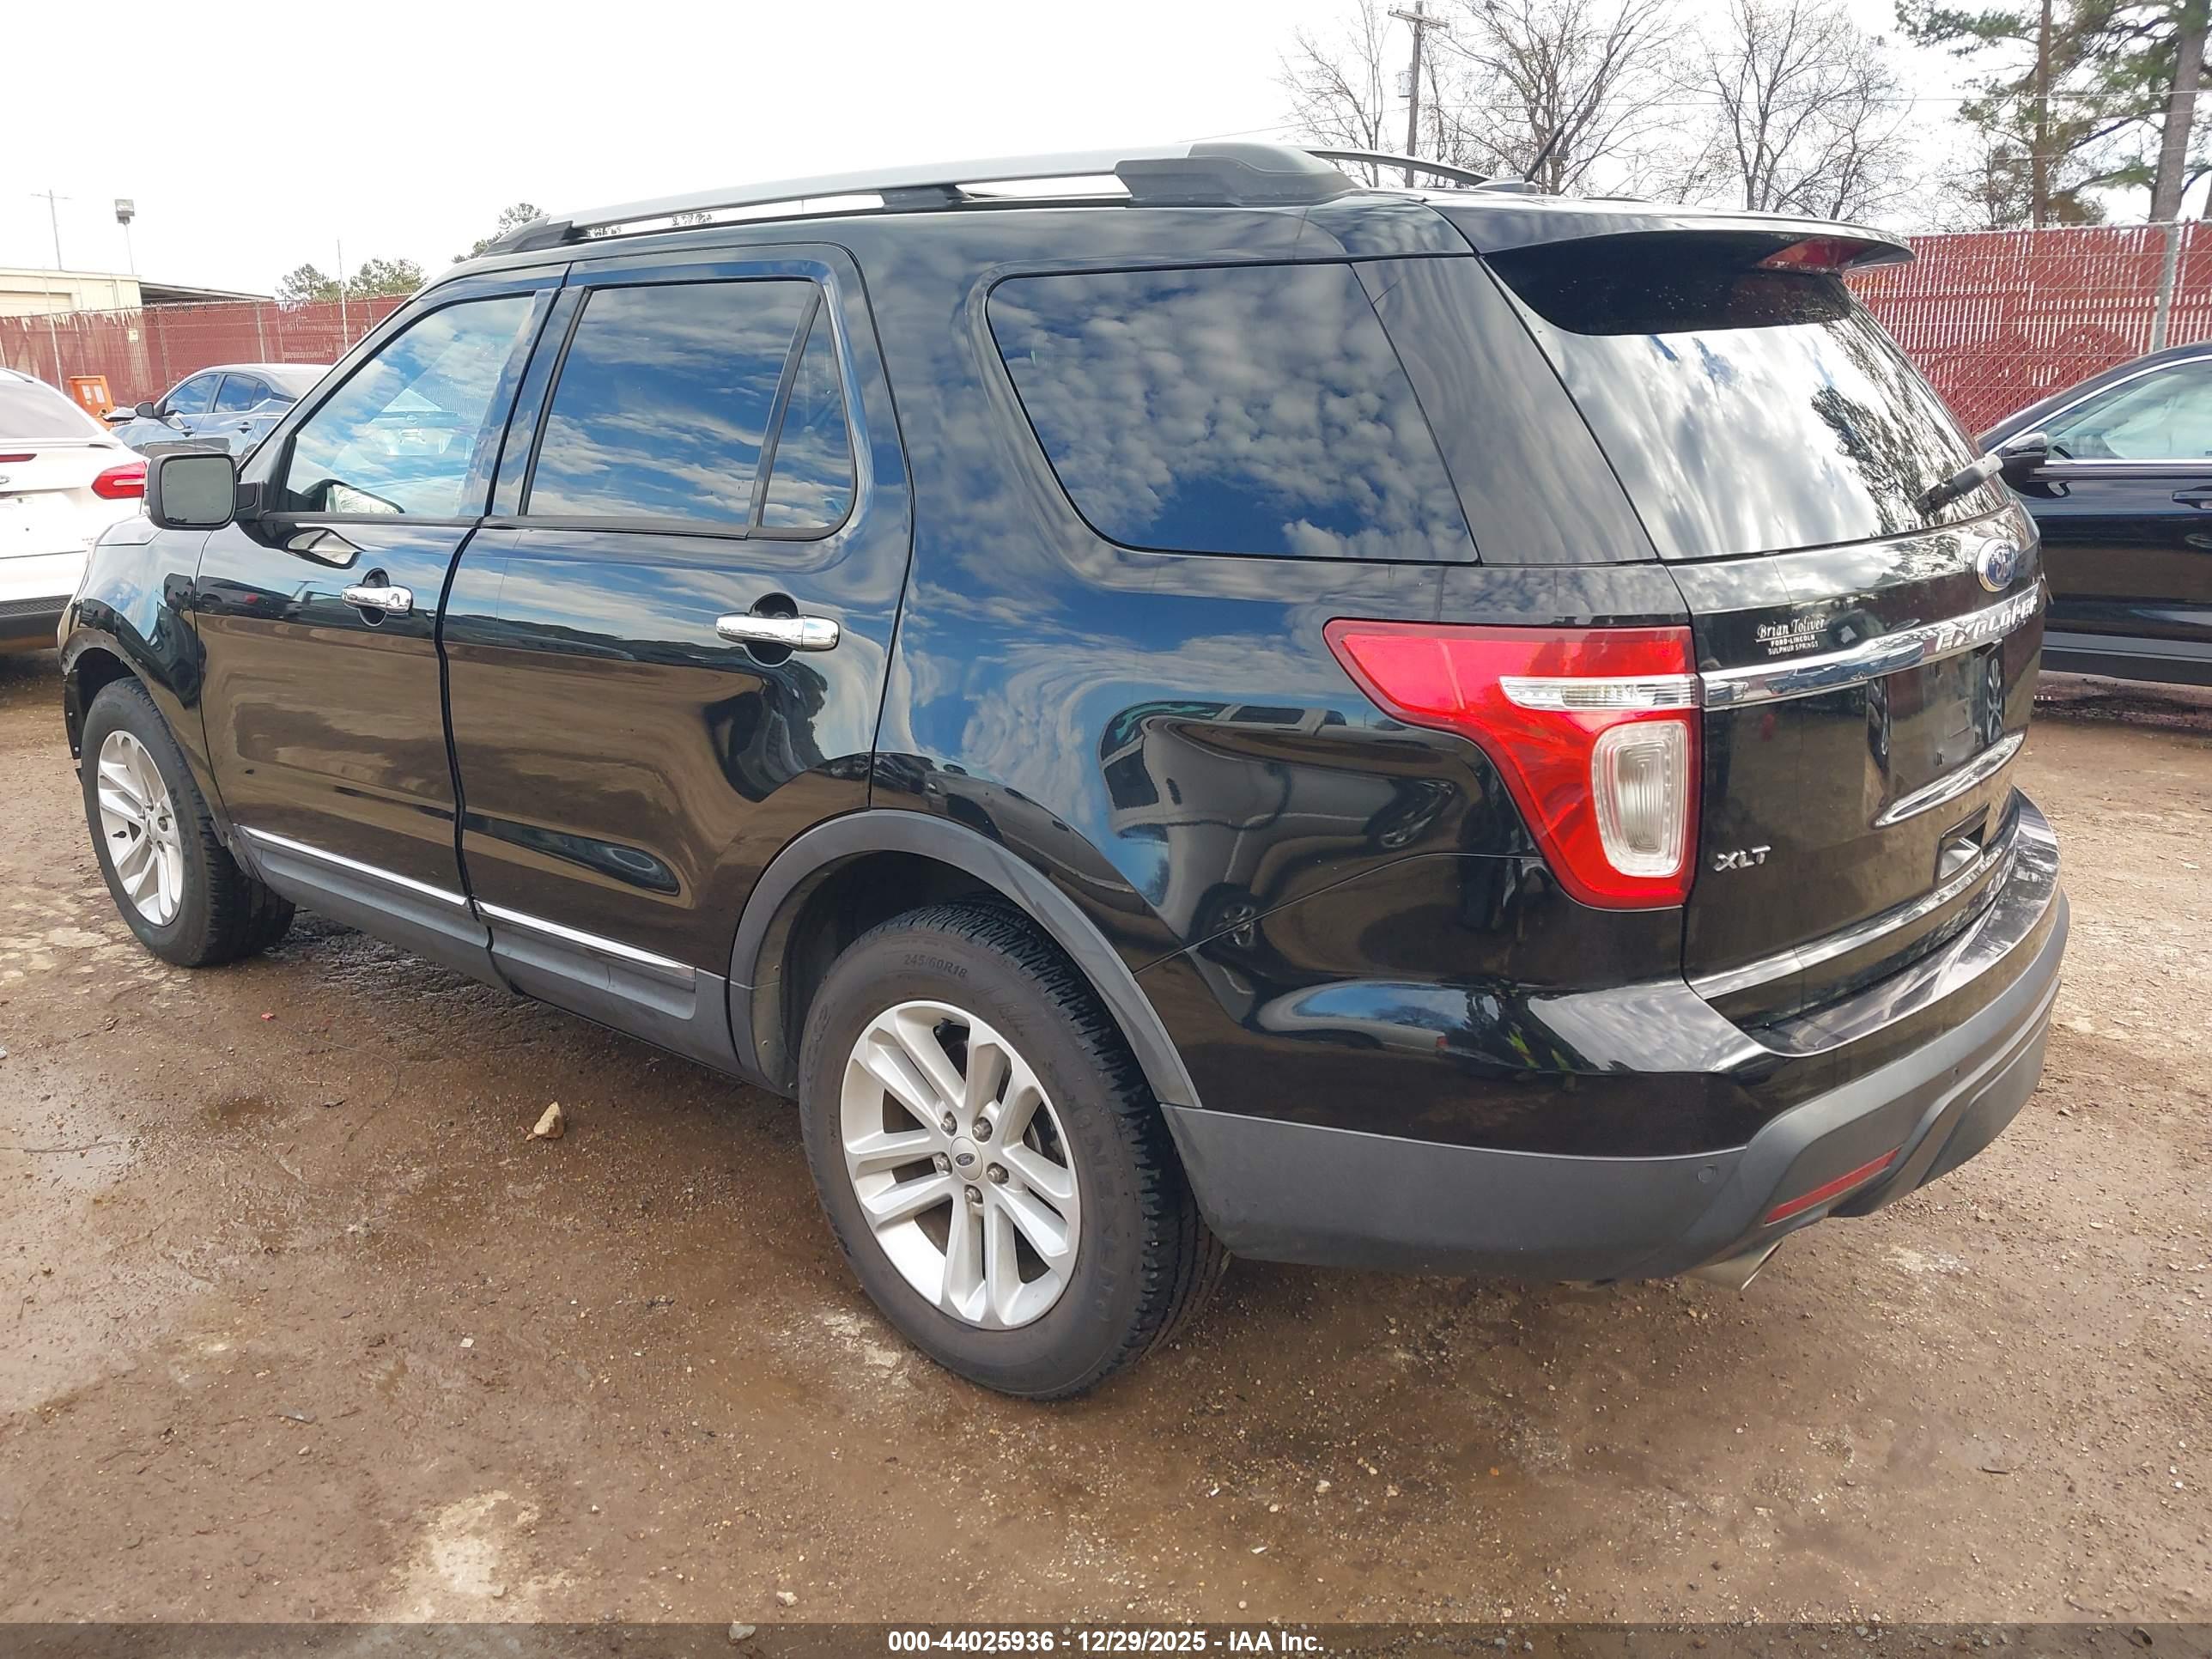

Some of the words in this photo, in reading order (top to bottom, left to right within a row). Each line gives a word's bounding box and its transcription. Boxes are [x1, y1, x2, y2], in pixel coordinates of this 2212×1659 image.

[1757, 620, 1790, 639] Brian
[1790, 615, 1826, 634] Toliver
[1767, 643, 1796, 655] SULPHUR
[1795, 640, 1820, 652] SPRINGS
[1712, 845, 1771, 872] XLT
[904, 945, 968, 977] 245/60R18
